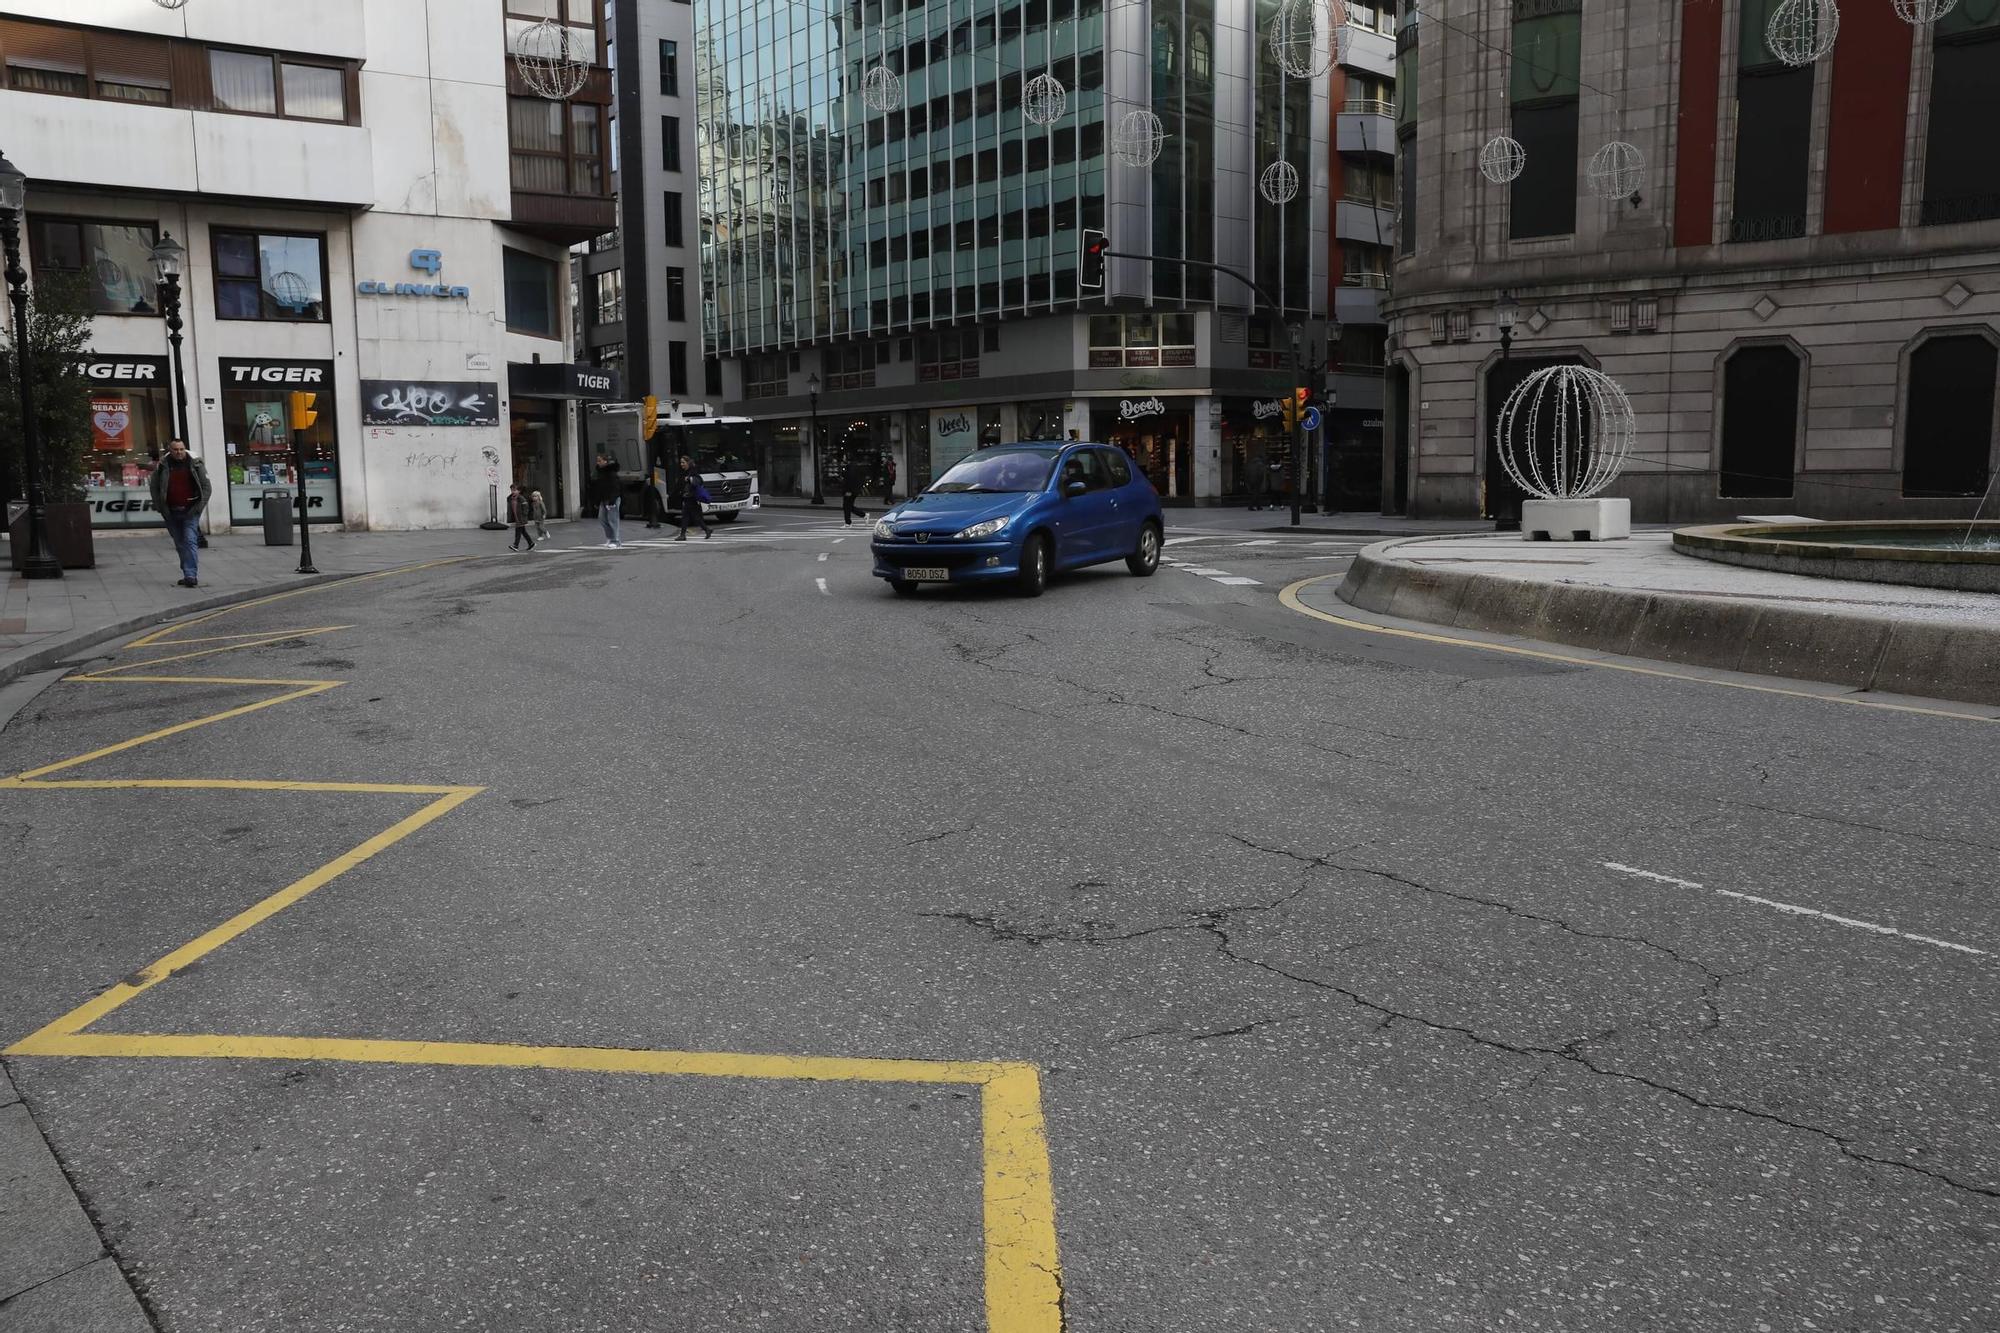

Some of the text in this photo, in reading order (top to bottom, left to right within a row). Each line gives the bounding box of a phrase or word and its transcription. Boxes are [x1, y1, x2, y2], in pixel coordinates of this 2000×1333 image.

[358, 281, 470, 298] CLINICA
[70, 362, 157, 380] IGER
[230, 366, 323, 383] TIGER
[577, 373, 610, 390] TIGER
[92, 404, 129, 412] REBAJAS
[250, 496, 324, 510] TER
[929, 569, 945, 580] DSZ
